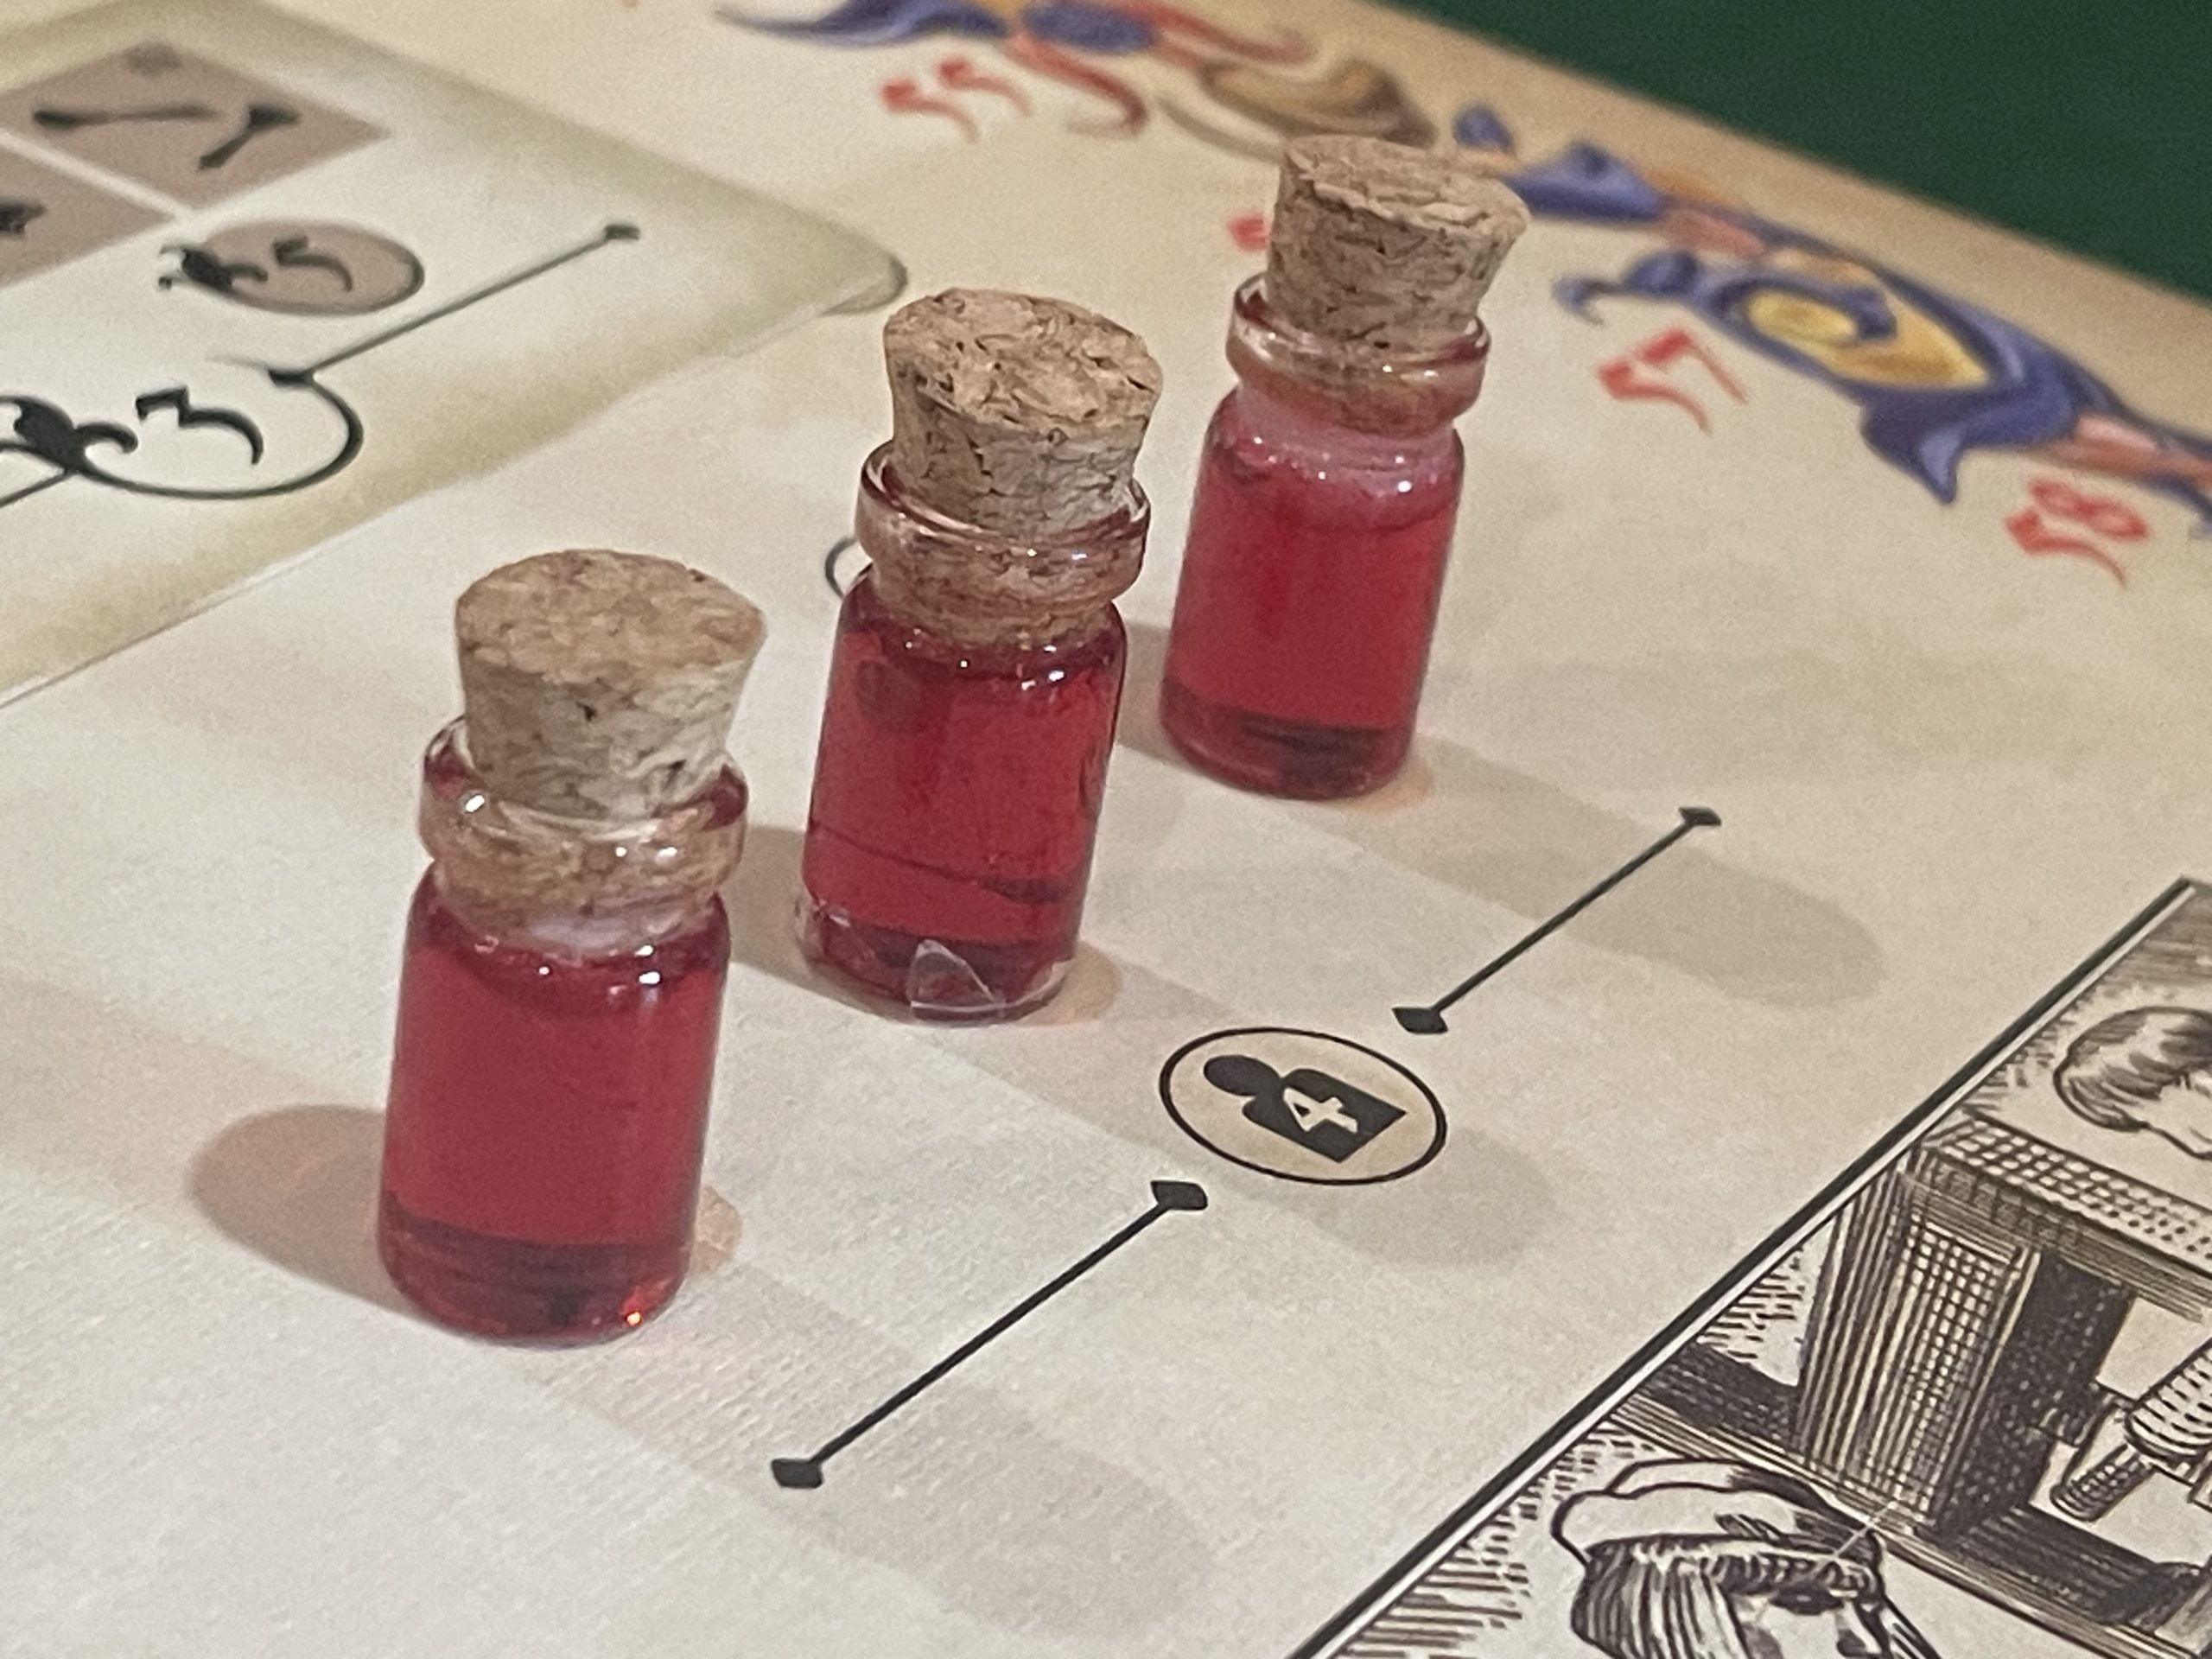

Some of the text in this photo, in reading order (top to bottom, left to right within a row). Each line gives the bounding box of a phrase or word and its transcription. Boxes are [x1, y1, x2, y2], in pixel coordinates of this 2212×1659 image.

[880, 56, 1031, 143] 55
[1597, 327, 1748, 435] 57
[2004, 475, 2150, 589] 58
[1282, 1087, 1359, 1135] 4
